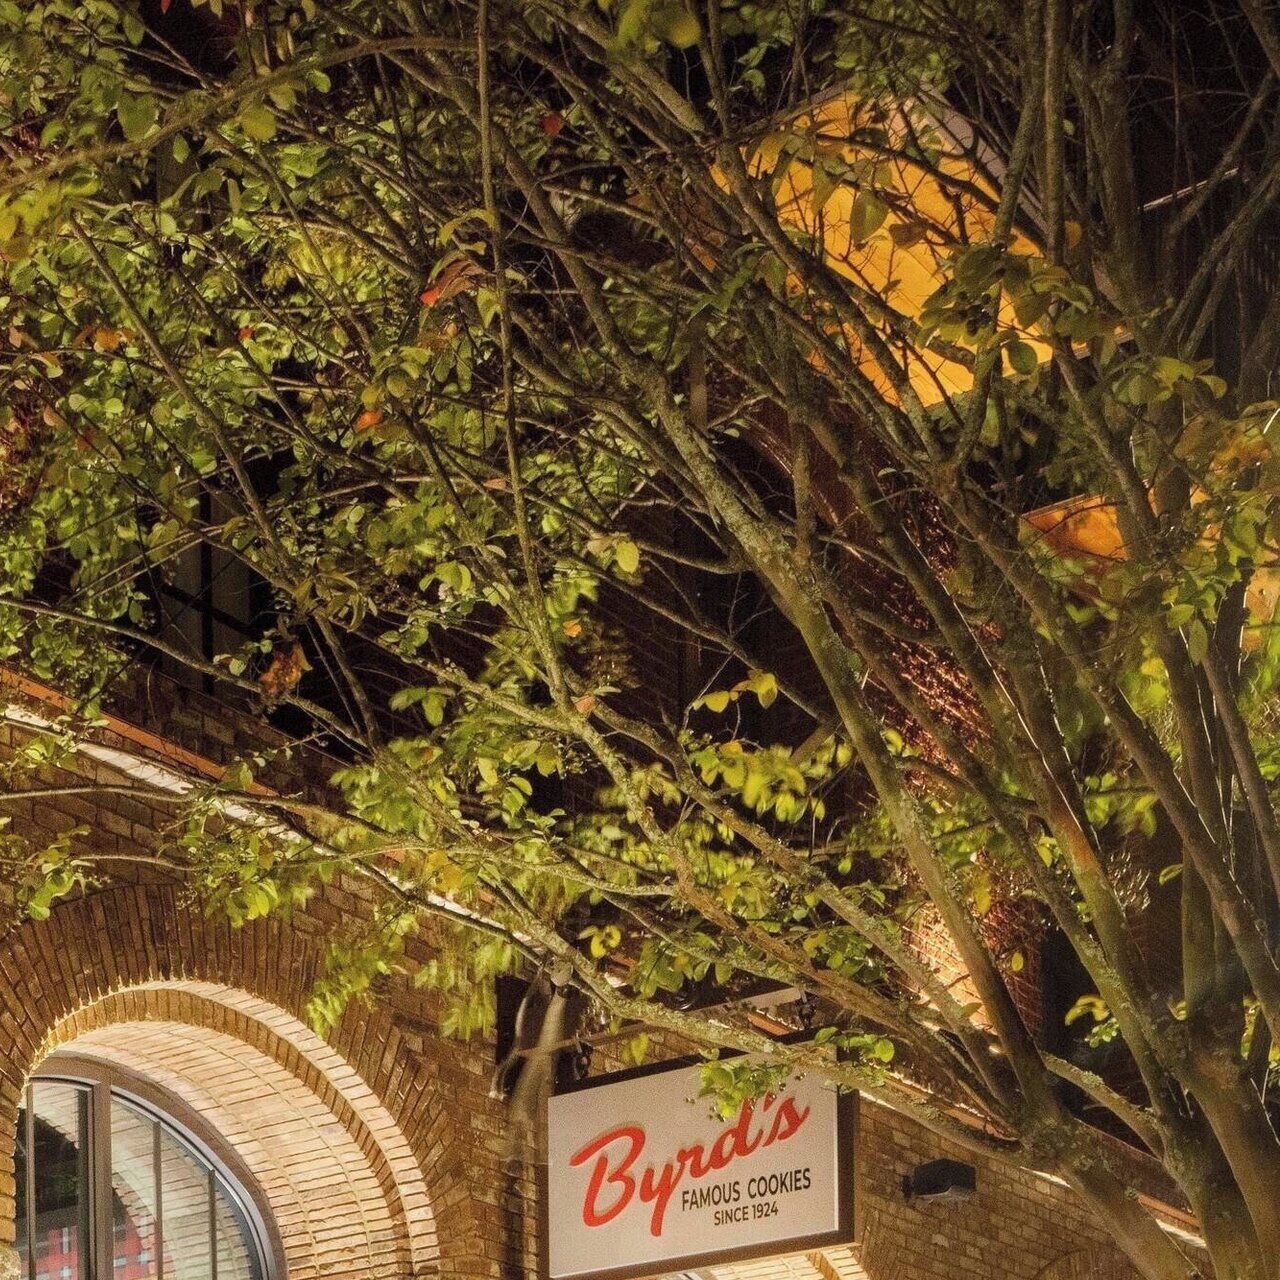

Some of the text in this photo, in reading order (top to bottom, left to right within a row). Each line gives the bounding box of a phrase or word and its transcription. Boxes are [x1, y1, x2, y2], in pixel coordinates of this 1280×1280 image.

[569, 1090, 812, 1238] Byrd's
[681, 1167, 813, 1212] FAMOUS COOKIES
[713, 1201, 780, 1227] SINCE 1924
